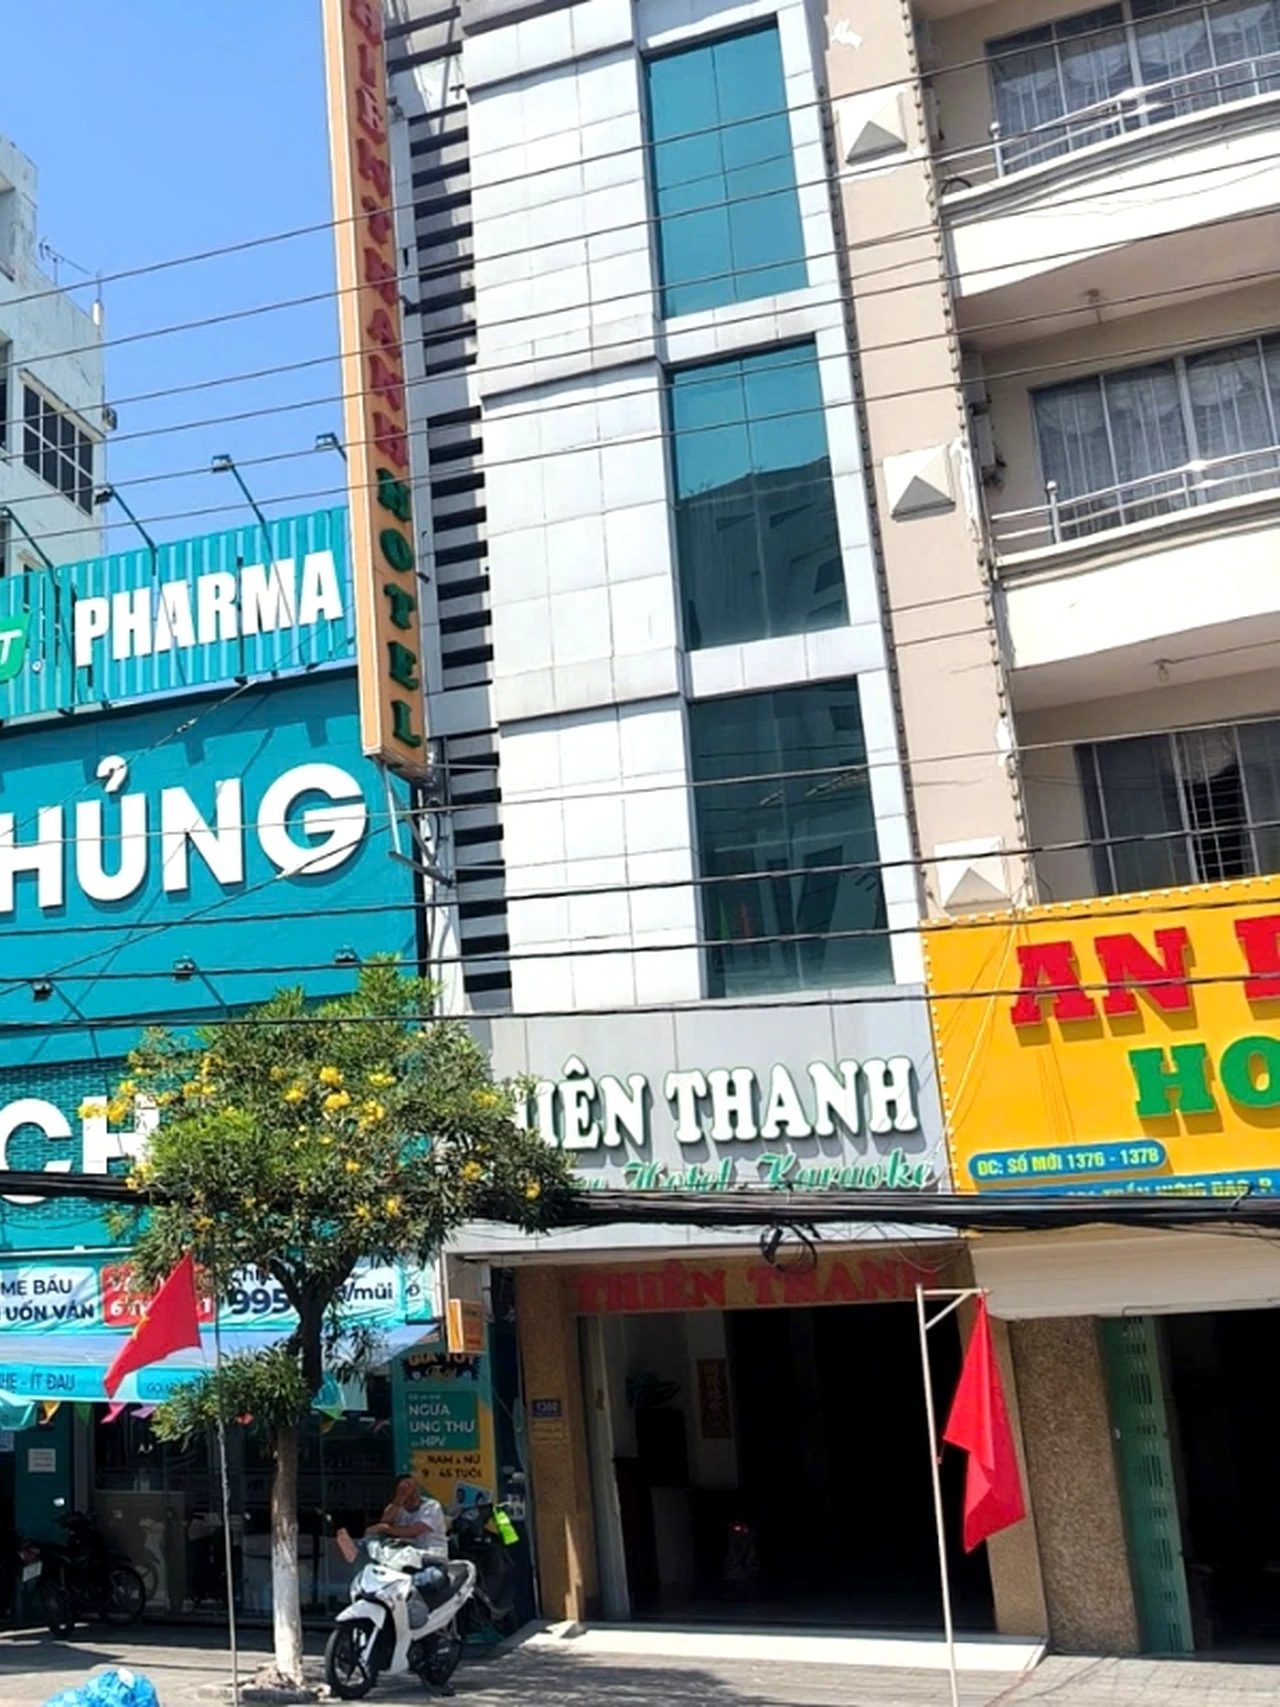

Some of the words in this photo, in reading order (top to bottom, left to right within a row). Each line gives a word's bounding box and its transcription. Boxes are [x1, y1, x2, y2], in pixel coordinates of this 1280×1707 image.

[74, 550, 345, 666] PHARMA
[375, 467, 421, 748] HOTEL
[1009, 926, 1191, 1026] AN
[518, 1053, 648, 1151] IÊN
[663, 1055, 919, 1145] THANH
[622, 1154, 733, 1191] Hotel
[757, 1147, 936, 1190] Karaoke
[977, 1160, 1005, 1178] ĐC:
[1007, 1150, 1029, 1174] SỐ
[1031, 1152, 1064, 1172] MỚI
[1120, 1147, 1160, 1166] 1378
[0, 1279, 28, 1300] MẸ
[573, 1257, 727, 1313] THIÊN
[746, 1256, 942, 1307] THANH
[5, 1300, 47, 1321] UỐN
[57, 1298, 95, 1319] VÁN
[110, 1300, 123, 1317] 6
[30, 1367, 45, 1390] ÍT
[46, 1374, 76, 1391] ĐAU
[409, 1419, 441, 1433] UNG
[445, 1419, 476, 1433] THƯ
[427, 1454, 454, 1465] NAM
